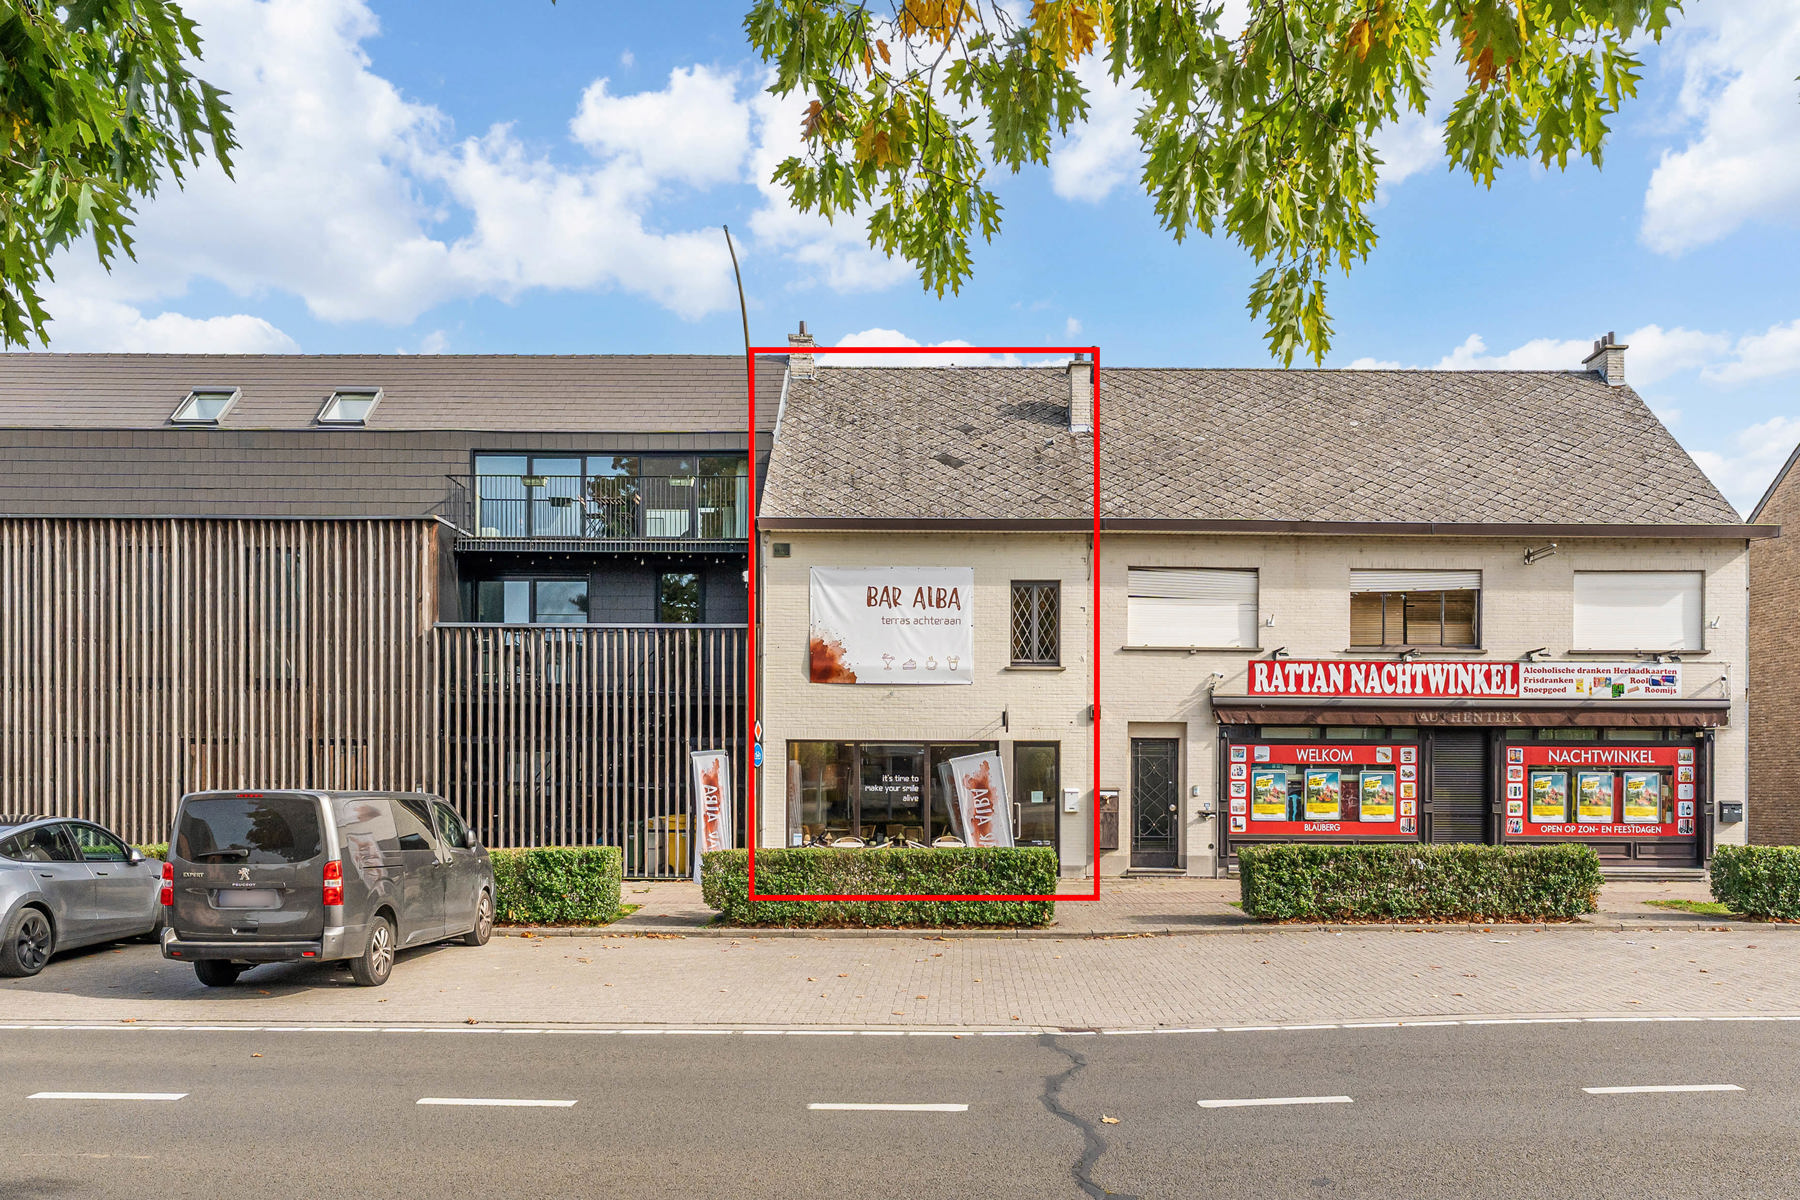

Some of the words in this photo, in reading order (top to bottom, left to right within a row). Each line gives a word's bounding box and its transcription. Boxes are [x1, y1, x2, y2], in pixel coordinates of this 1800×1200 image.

[867, 586, 902, 609] BAR
[912, 586, 961, 610] ALBA
[881, 616, 911, 625] terras
[913, 616, 962, 625] achteraan
[1523, 667, 1576, 675] Alcoholische
[1577, 667, 1611, 675] dranken
[1613, 667, 1678, 676] Herlaadkaarten
[1254, 663, 1345, 693] RATTAN
[1350, 663, 1518, 695] NACHTWINKEL
[1523, 686, 1567, 695] Snoepgoed
[1644, 686, 1678, 695] Roomijs
[1419, 712, 1523, 724] AUTHENTIEK
[1296, 748, 1353, 762] WELKOM
[1548, 749, 1656, 763] NACHTWINKEL
[882, 774, 893, 782] it's
[895, 774, 910, 782] time
[911, 774, 920, 782] to
[864, 784, 884, 792] make
[885, 785, 901, 794] your
[902, 784, 919, 792] smile
[902, 794, 920, 802] alive
[1304, 823, 1341, 832] BLAUBERG
[1540, 825, 1564, 834] OPEN
[1564, 826, 1577, 834] OP
[1578, 826, 1599, 834] ZON-
[1601, 826, 1612, 834] EN
[1613, 826, 1662, 834] FEESTDAGEN
